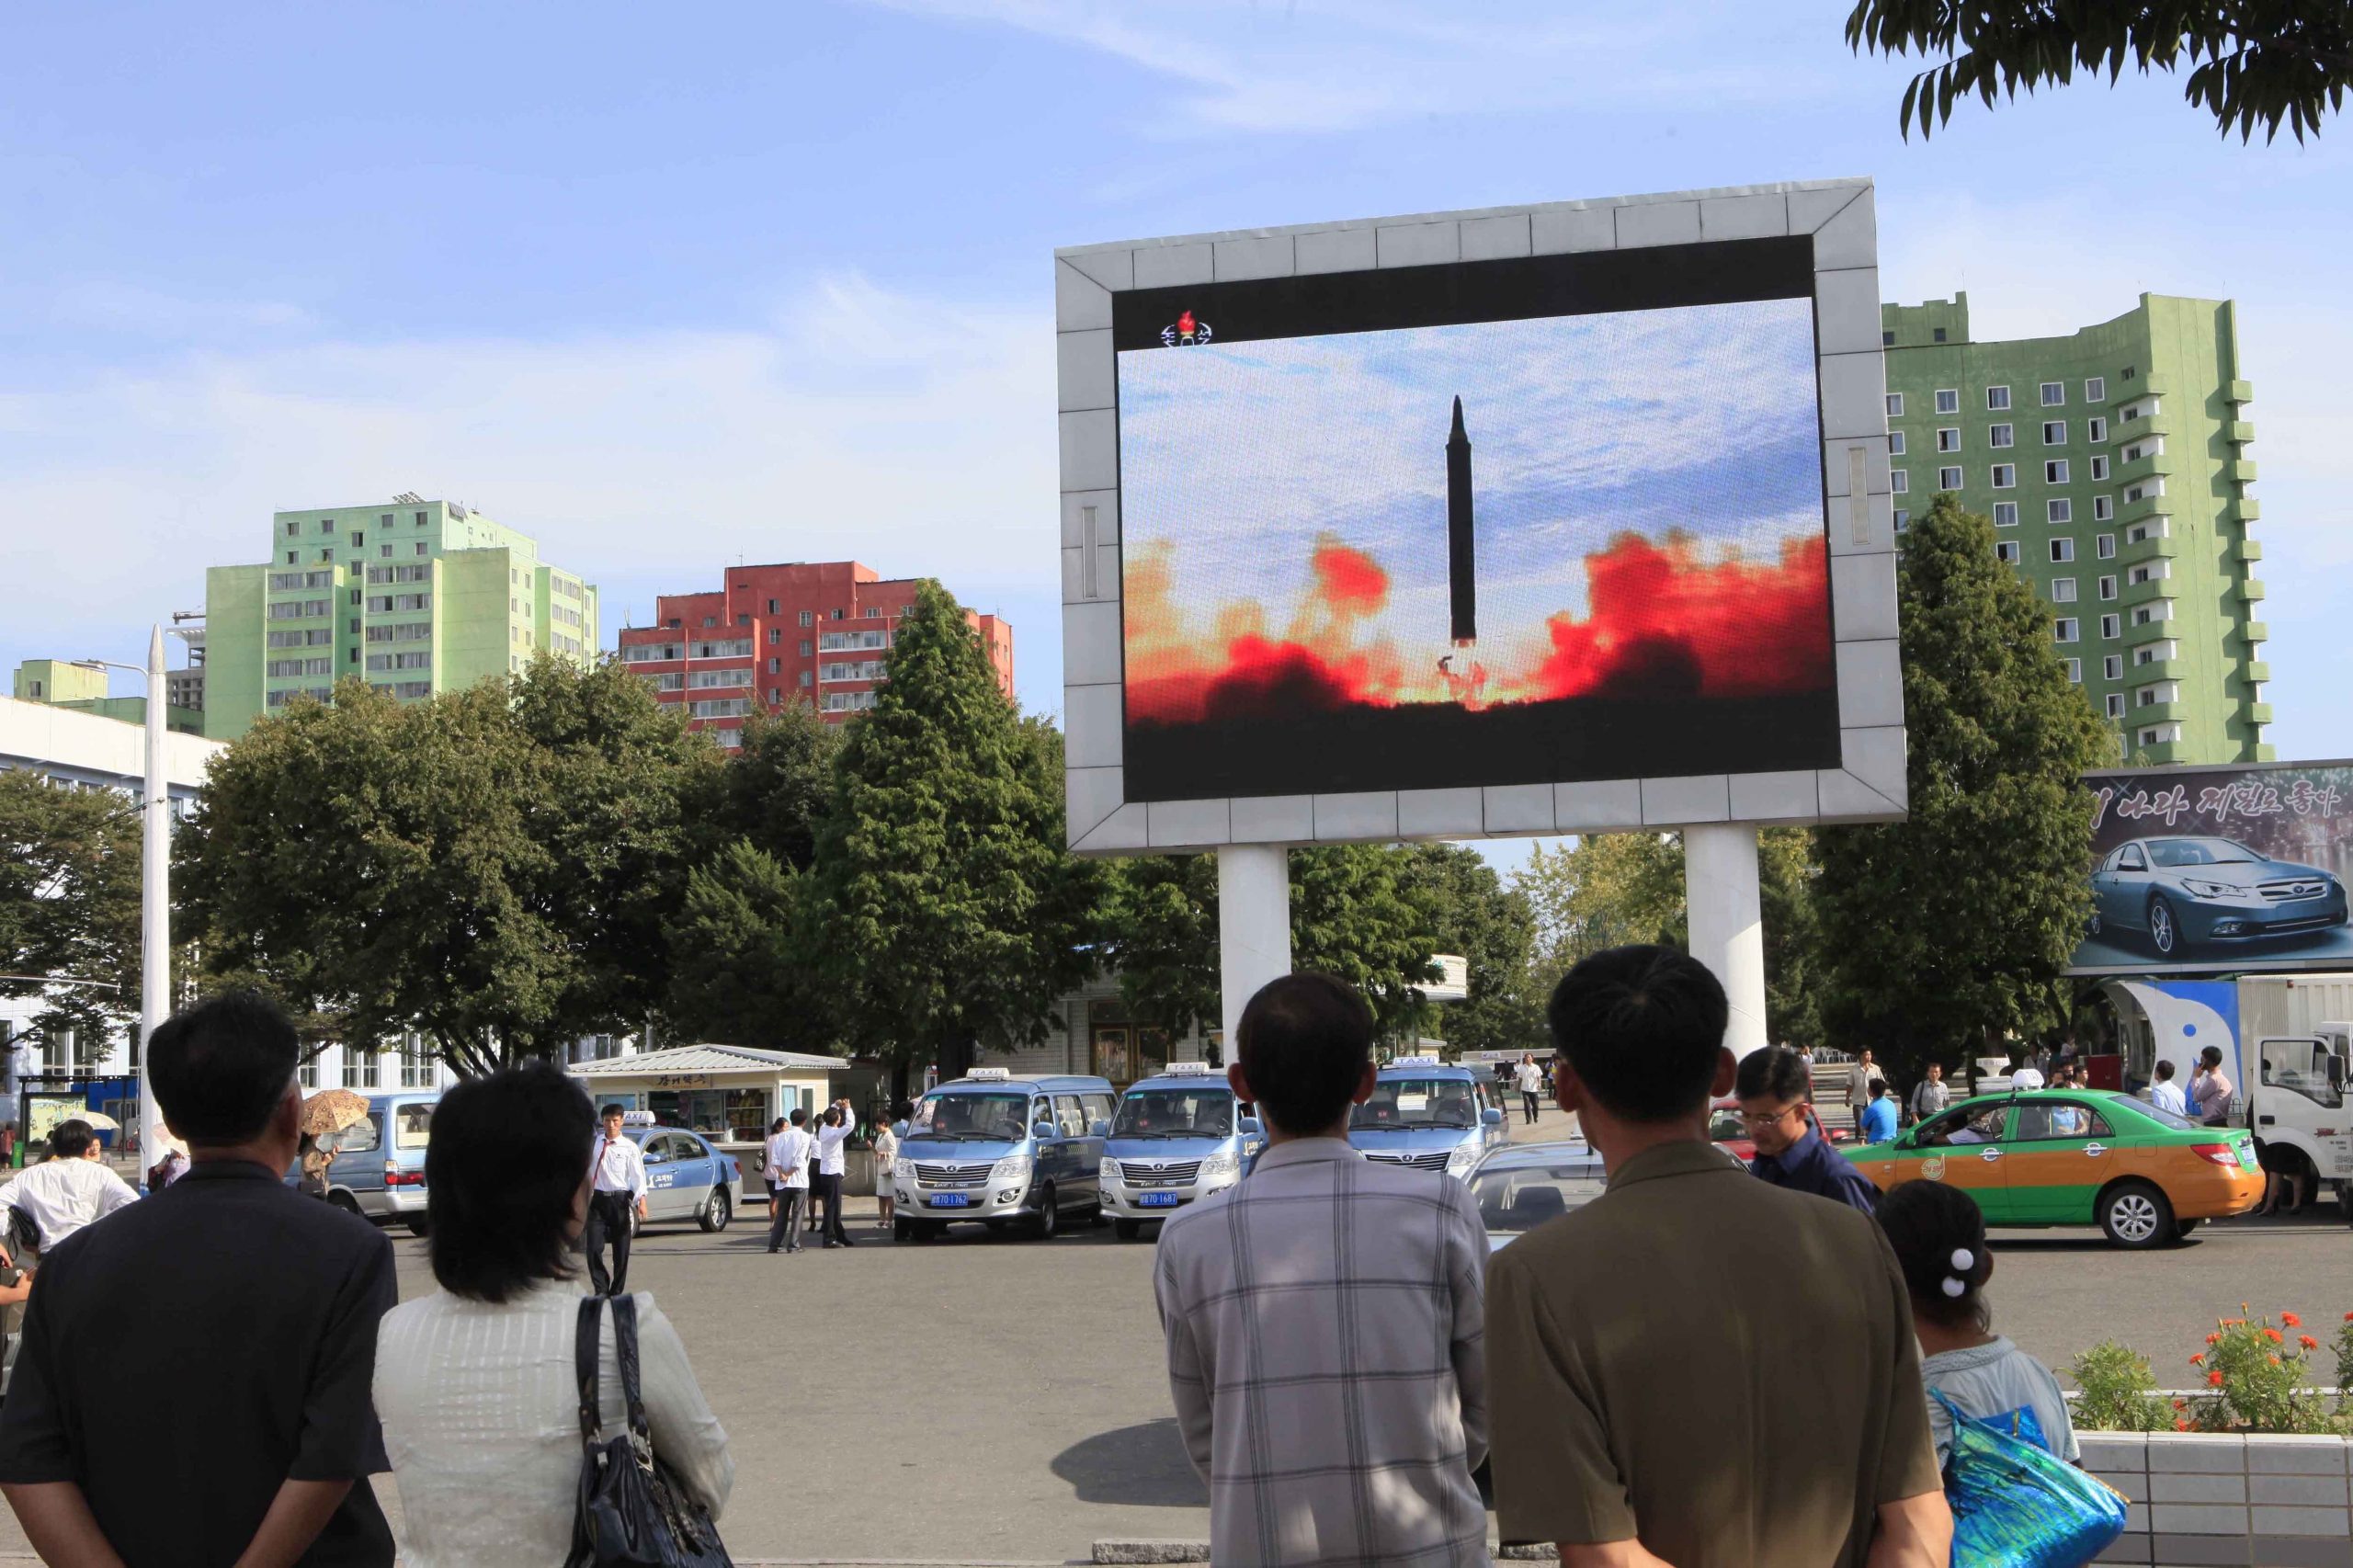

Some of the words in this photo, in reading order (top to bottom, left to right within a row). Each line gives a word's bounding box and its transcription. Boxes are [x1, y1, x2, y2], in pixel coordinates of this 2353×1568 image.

[2117, 784, 2190, 826] 나라
[2196, 783, 2284, 823] 제일로
[2284, 780, 2342, 818] 좋아
